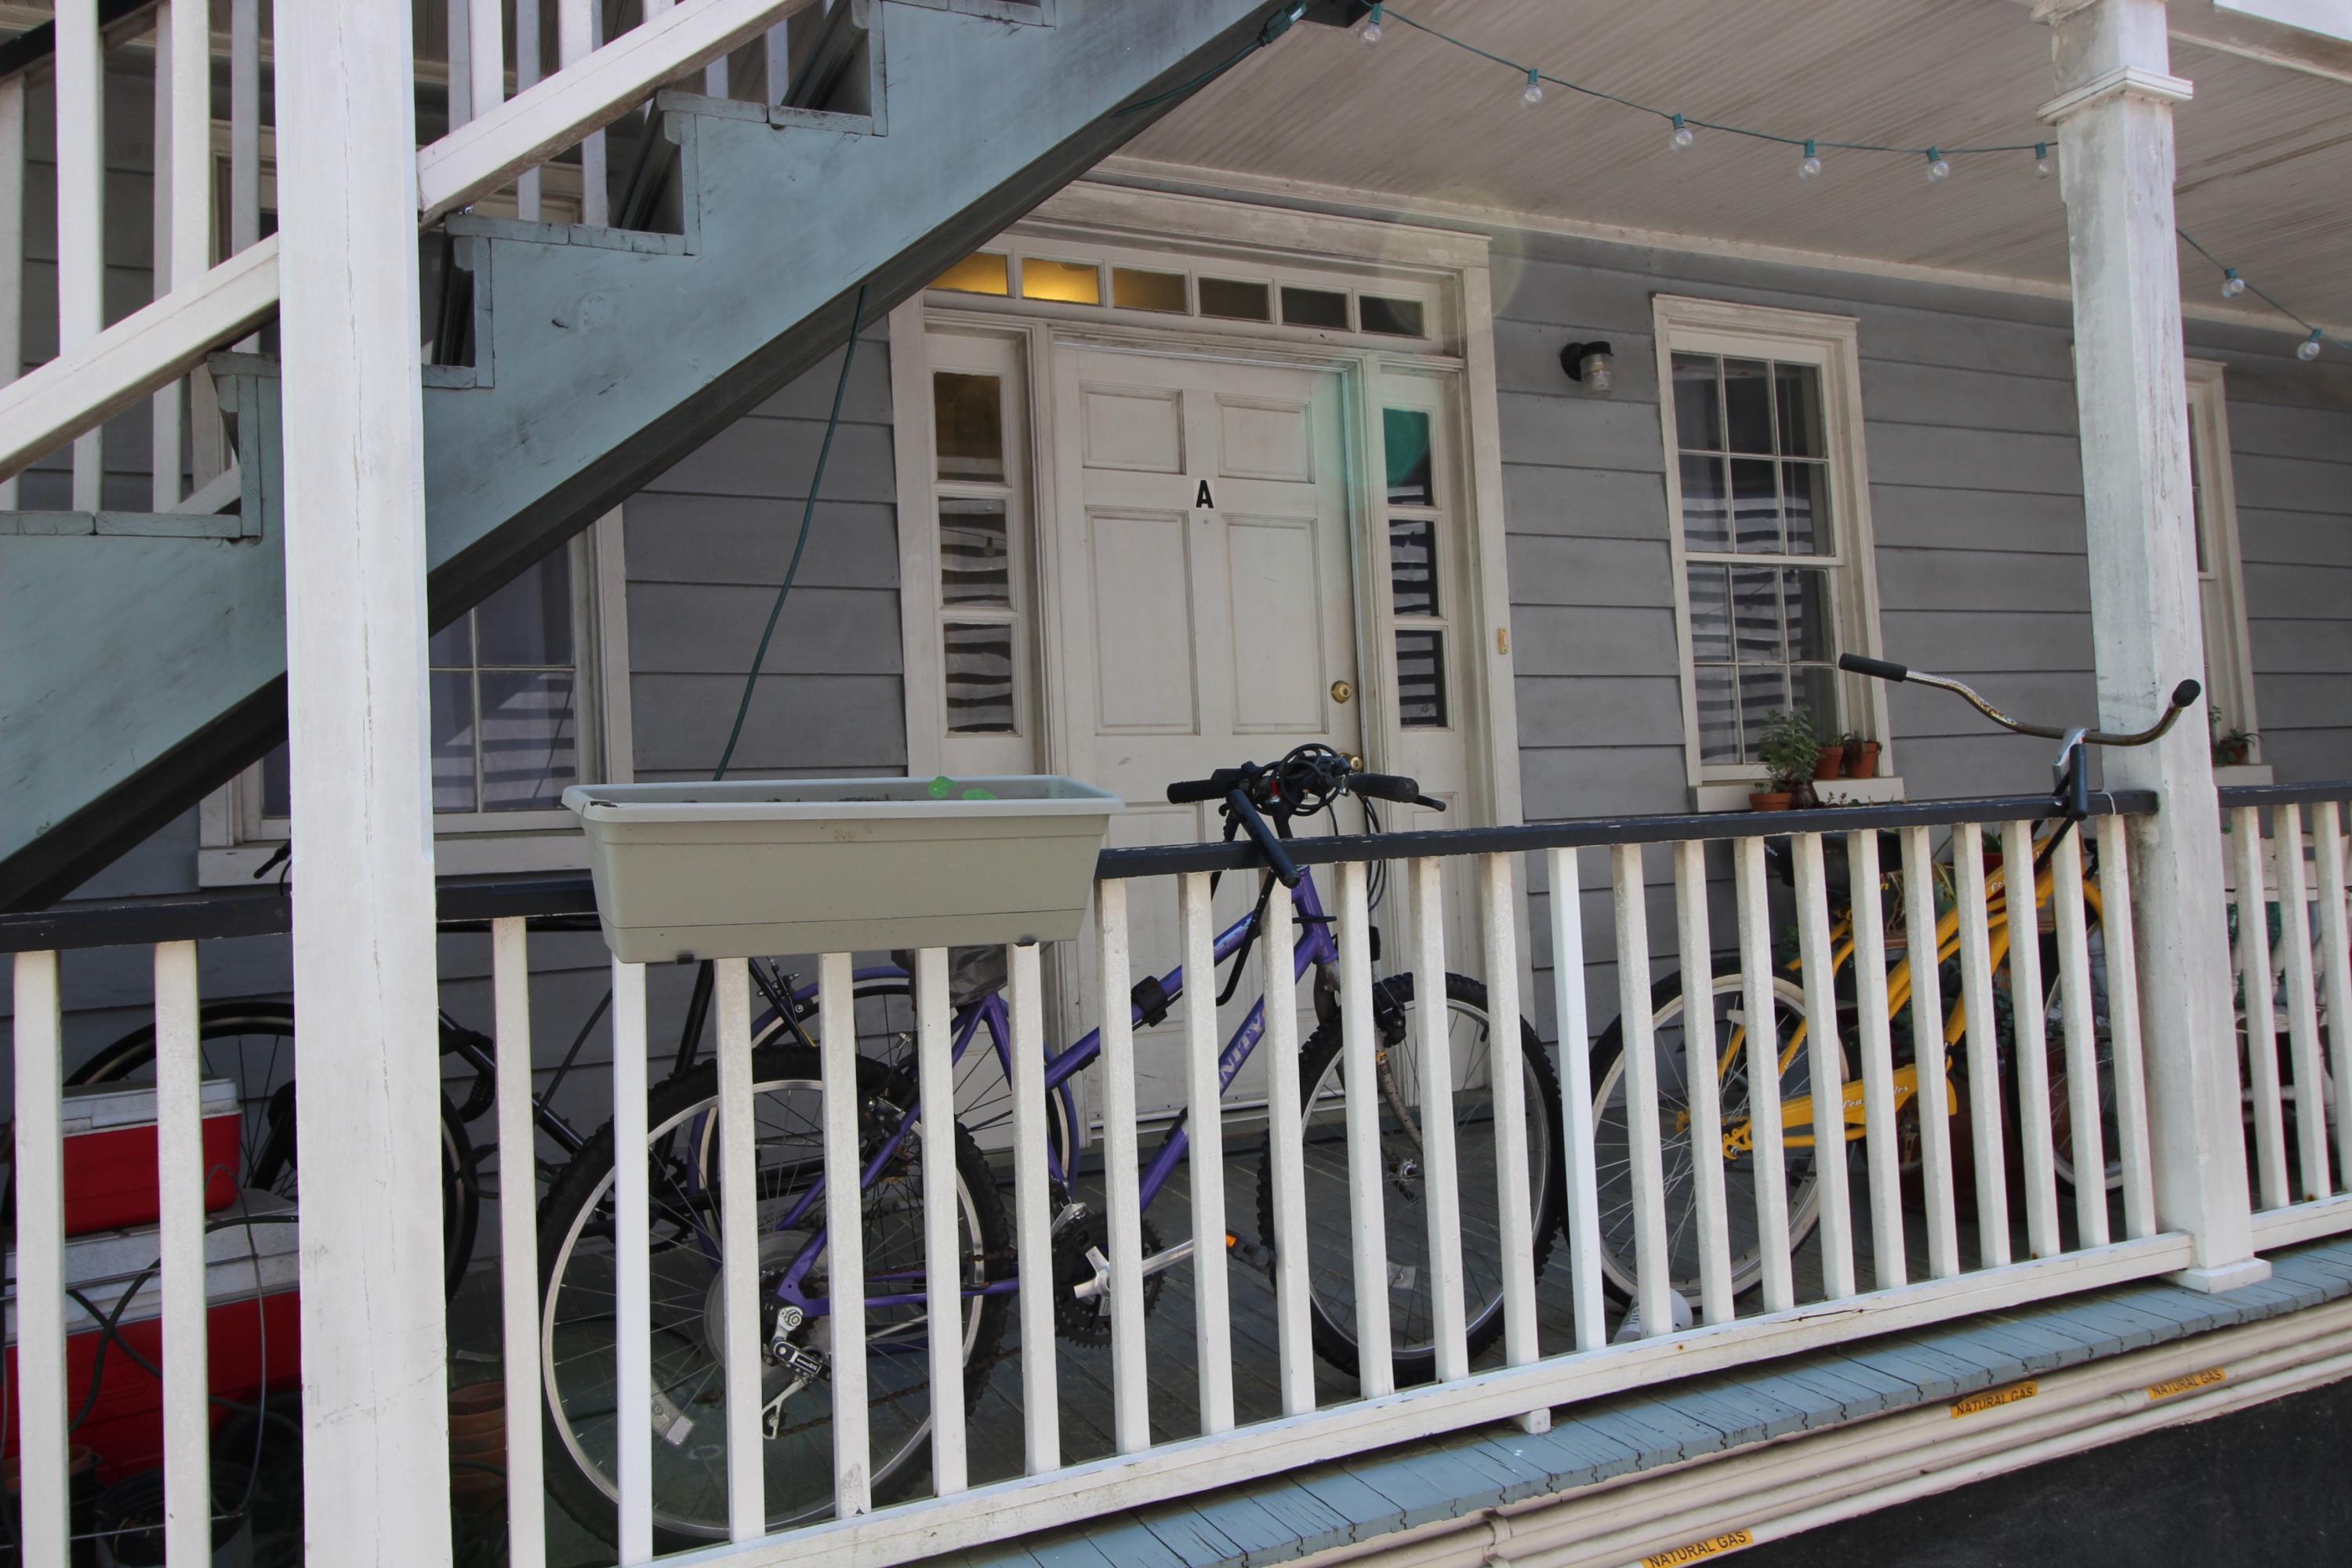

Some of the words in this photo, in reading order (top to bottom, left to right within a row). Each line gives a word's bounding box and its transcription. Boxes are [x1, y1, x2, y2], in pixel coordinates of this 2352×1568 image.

[1196, 480, 1214, 509] A
[1219, 1011, 1262, 1087] NITY
[2151, 1376, 2199, 1397] NATURAL
[2201, 1368, 2221, 1384] GAS
[1956, 1394, 2007, 1416] NATURAL
[2011, 1387, 2033, 1402] GAS
[1648, 1541, 1715, 1568] NATURAL
[1717, 1531, 1747, 1548] GAS
